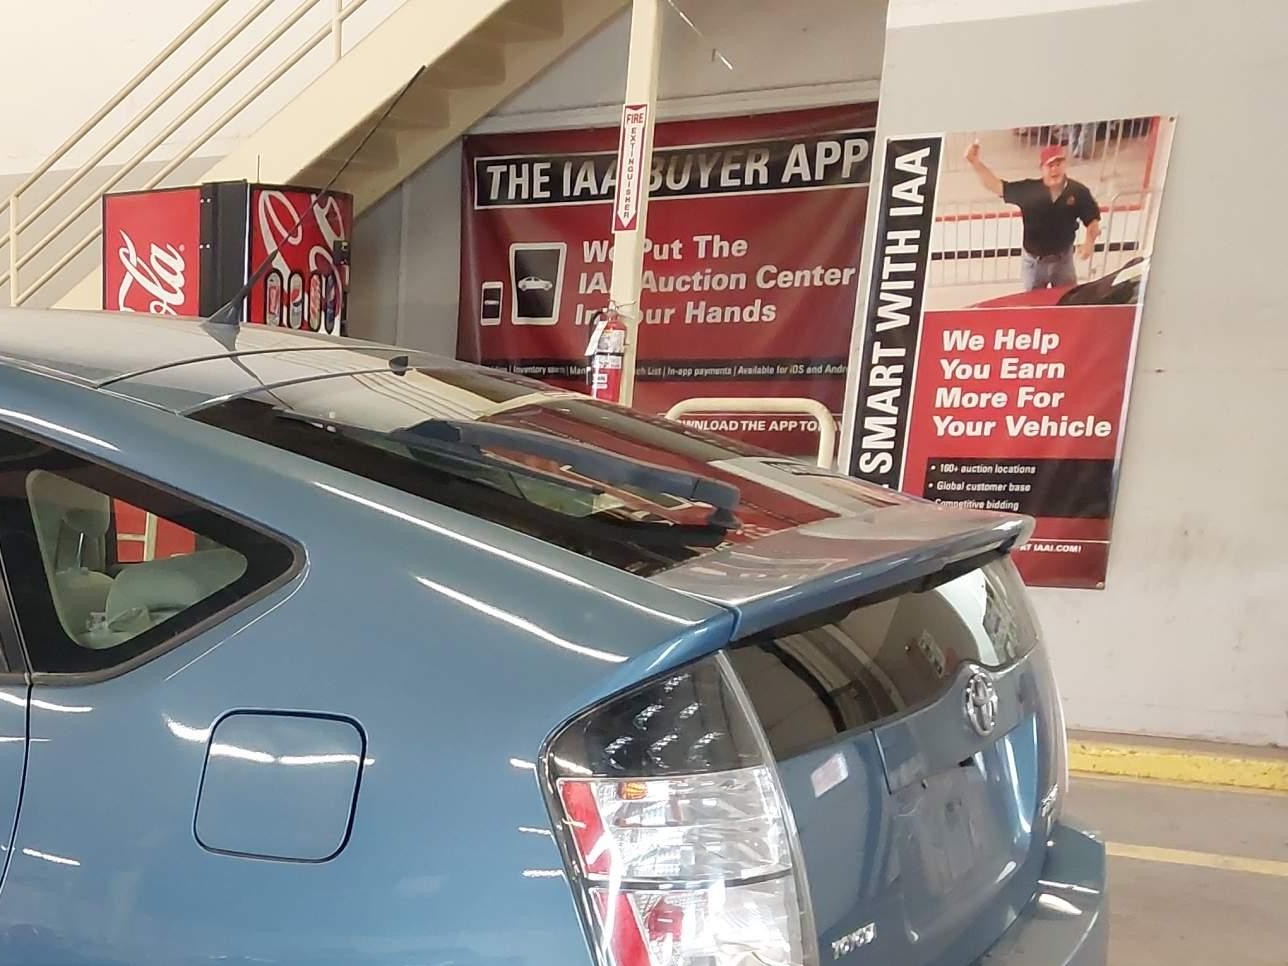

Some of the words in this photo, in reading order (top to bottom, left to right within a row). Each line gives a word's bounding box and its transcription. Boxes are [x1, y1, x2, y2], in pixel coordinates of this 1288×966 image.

[626, 113, 644, 124] FIRE
[486, 162, 551, 200] THE
[649, 148, 771, 191] BUYER
[781, 138, 869, 183] APP
[623, 127, 637, 218] EXTINGUISHER
[889, 147, 931, 217] IAA
[693, 235, 748, 259] The
[578, 272, 612, 294] IA
[641, 269, 746, 293] Auction
[756, 264, 857, 289] Center
[875, 230, 921, 332] WITH
[685, 299, 777, 324] Hands
[942, 329, 984, 351] We
[994, 328, 1060, 355] Help
[667, 366, 692, 377] In-app
[694, 367, 732, 377] payments
[738, 366, 774, 374] Available
[776, 365, 789, 374] for
[789, 365, 804, 374] iOS
[806, 365, 822, 374] and
[939, 358, 991, 380] You
[1000, 357, 1065, 379] Earn
[859, 341, 907, 475] SMART
[935, 387, 1008, 408] More
[1017, 386, 1064, 408] For
[740, 420, 767, 432] THE
[768, 420, 798, 432] APP
[932, 415, 997, 437] Your
[1005, 415, 1112, 437] Vehicle
[961, 464, 992, 473] auction
[995, 464, 1036, 474] locations
[936, 481, 965, 490] Global
[966, 483, 1007, 491] customer
[1008, 482, 1031, 491] base
[986, 500, 1019, 511] bidding
